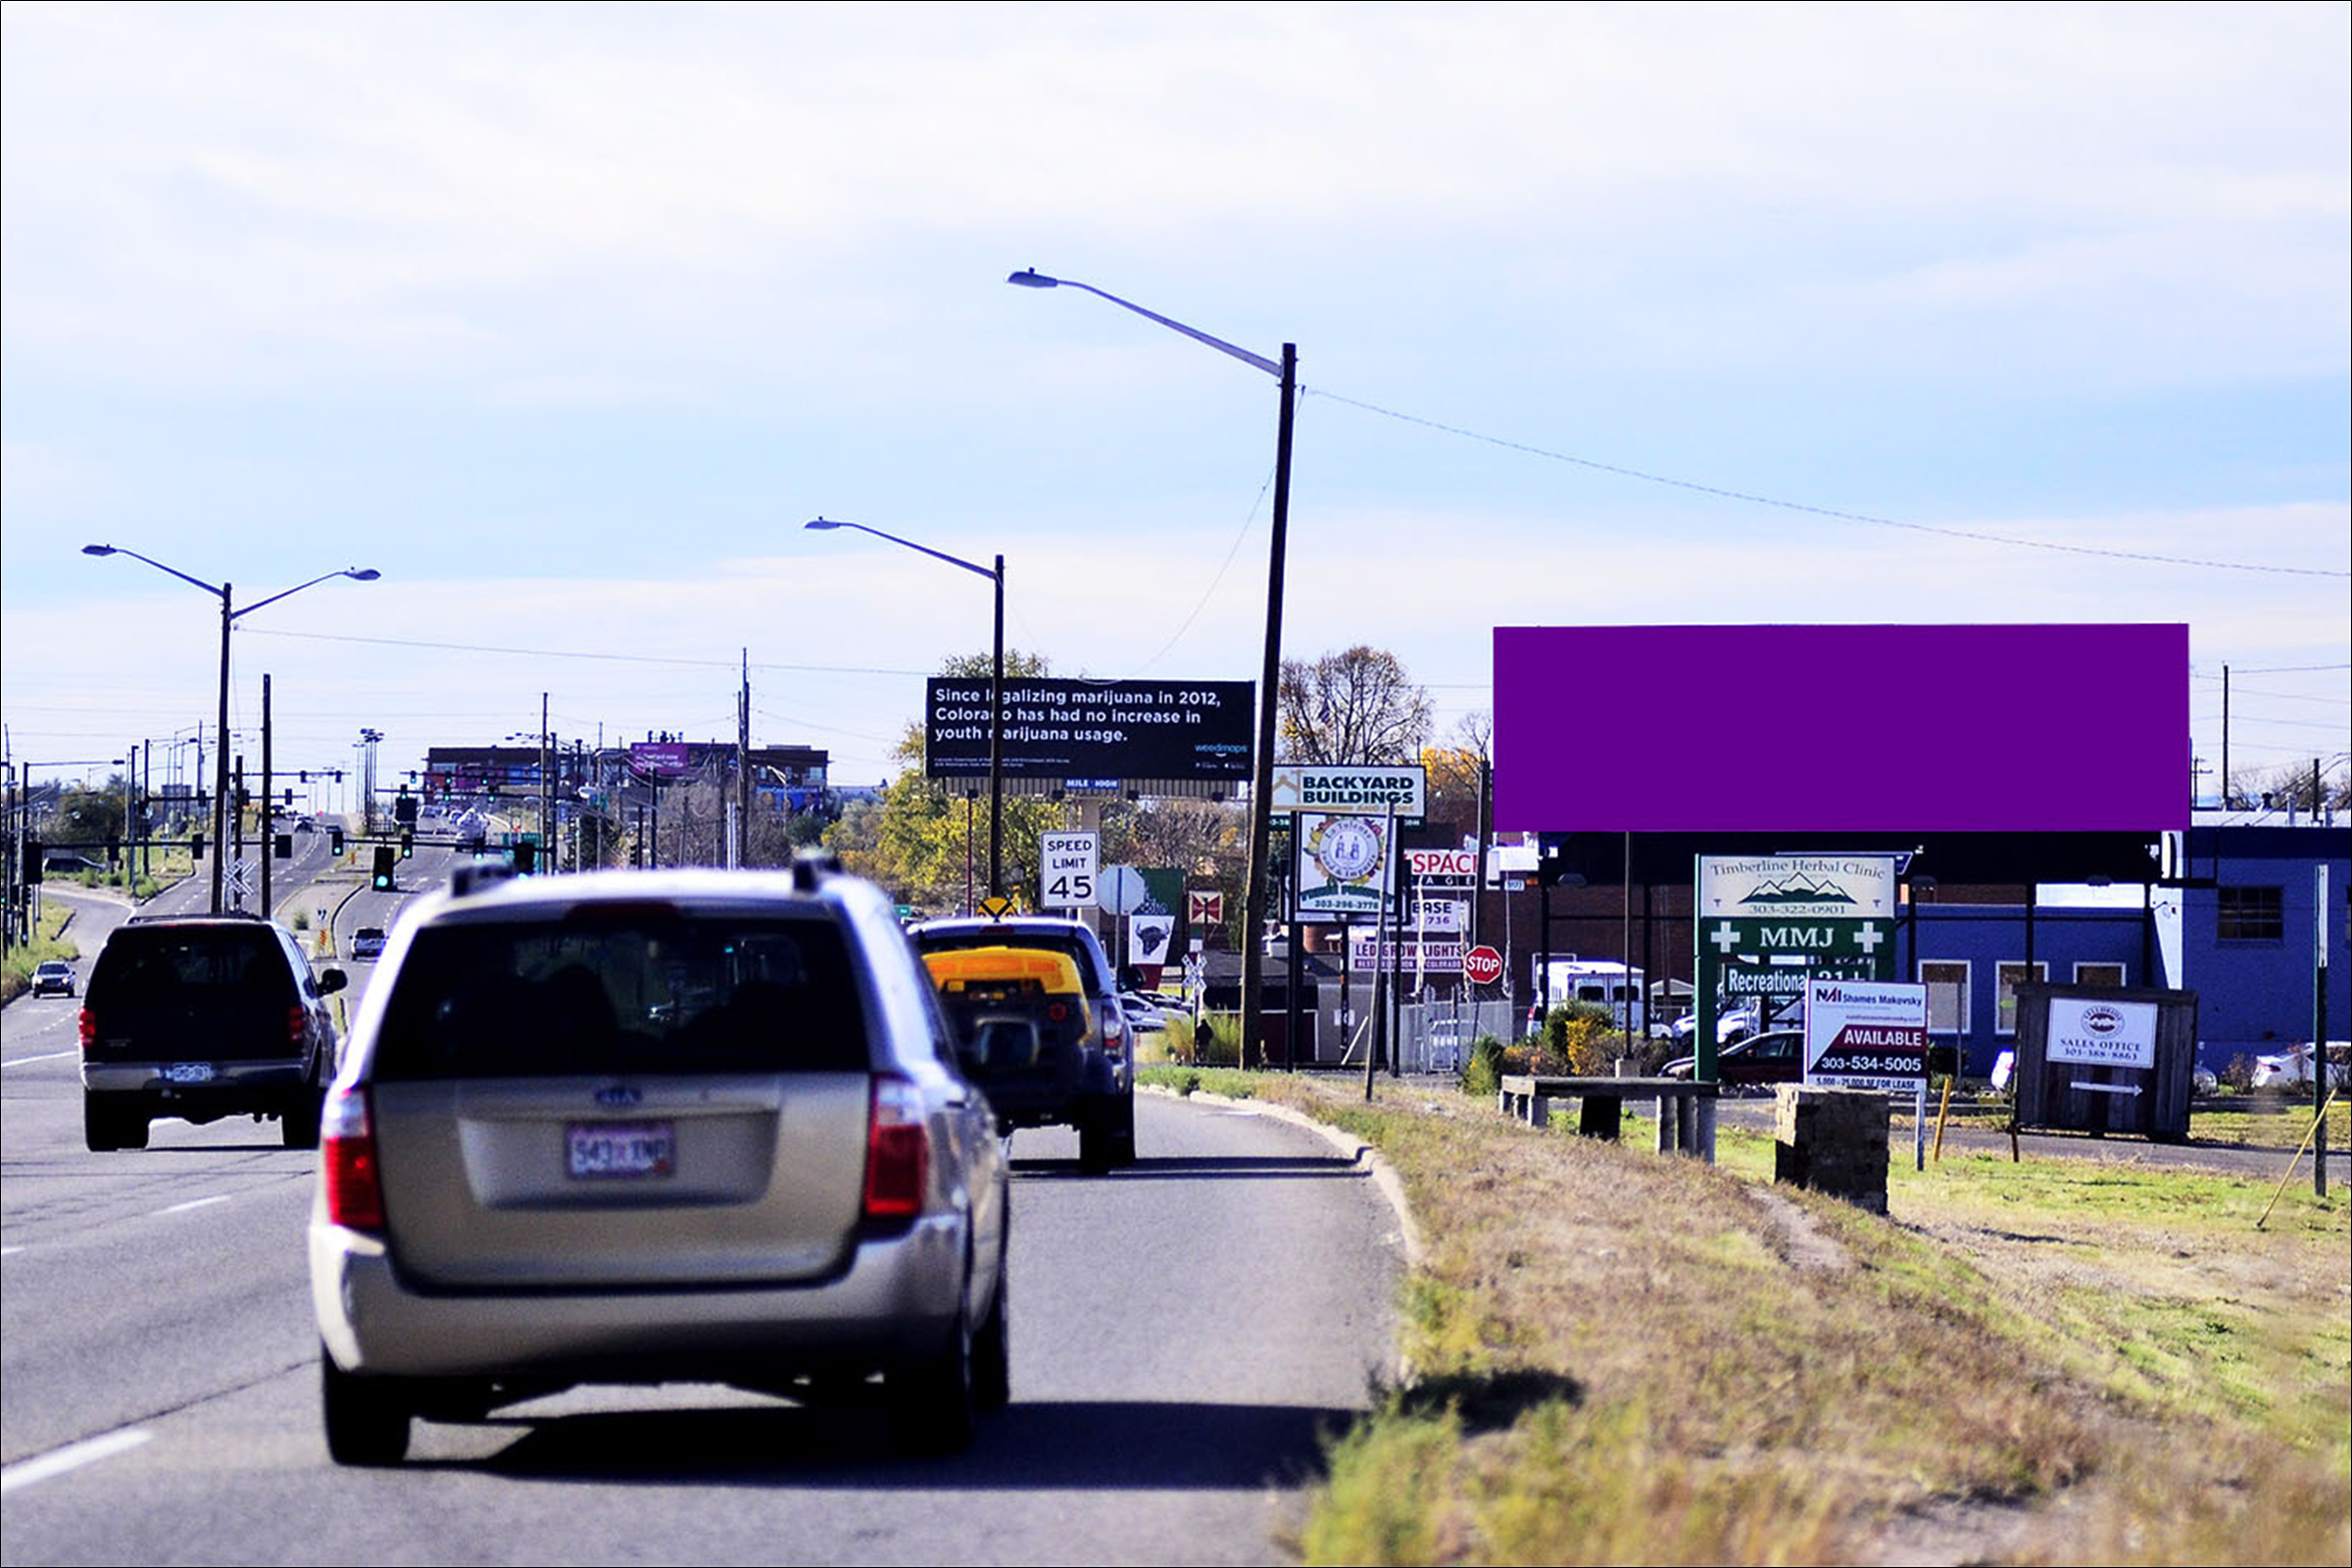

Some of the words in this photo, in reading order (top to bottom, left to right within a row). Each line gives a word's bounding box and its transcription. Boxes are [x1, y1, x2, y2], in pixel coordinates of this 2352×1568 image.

[935, 688, 980, 702] Since
[1072, 690, 1153, 706] marijuana
[1158, 691, 1174, 704] in
[1179, 692, 1222, 707] 2012,
[1017, 708, 1045, 721] has
[1051, 708, 1081, 722] had
[1086, 710, 1107, 722] no
[1112, 709, 1181, 723] increase
[1186, 710, 1201, 723] in
[935, 725, 982, 742] youth
[1074, 730, 1128, 744] usage.
[1195, 744, 1248, 754] weedmaps
[1302, 776, 1414, 790] BACKYARD
[1302, 791, 1414, 805] BUILDINGS
[1047, 840, 1093, 852] SPEED
[1052, 858, 1087, 869] LIMIT
[1710, 859, 1788, 876] Timberline
[1792, 859, 1839, 872] Herbal
[1843, 861, 1886, 880] Clinic
[1048, 875, 1093, 899] 45
[1748, 905, 1845, 914] 303-322-0901
[1759, 927, 1835, 948] MMJ
[1355, 944, 1377, 957] LED
[1423, 944, 1462, 957] LIGHTS
[1466, 956, 1499, 972] STOP
[1816, 987, 1842, 1002] NAI
[1843, 994, 1877, 1004] Shames
[1879, 995, 1922, 1007] Makovsky
[1843, 1029, 1922, 1047] AVAILABLE
[2060, 1039, 2095, 1048] SALES
[2099, 1041, 2140, 1052] OFFICE
[1821, 1055, 1922, 1072] 303-534-5005
[1892, 1080, 1916, 1090] LEASE
